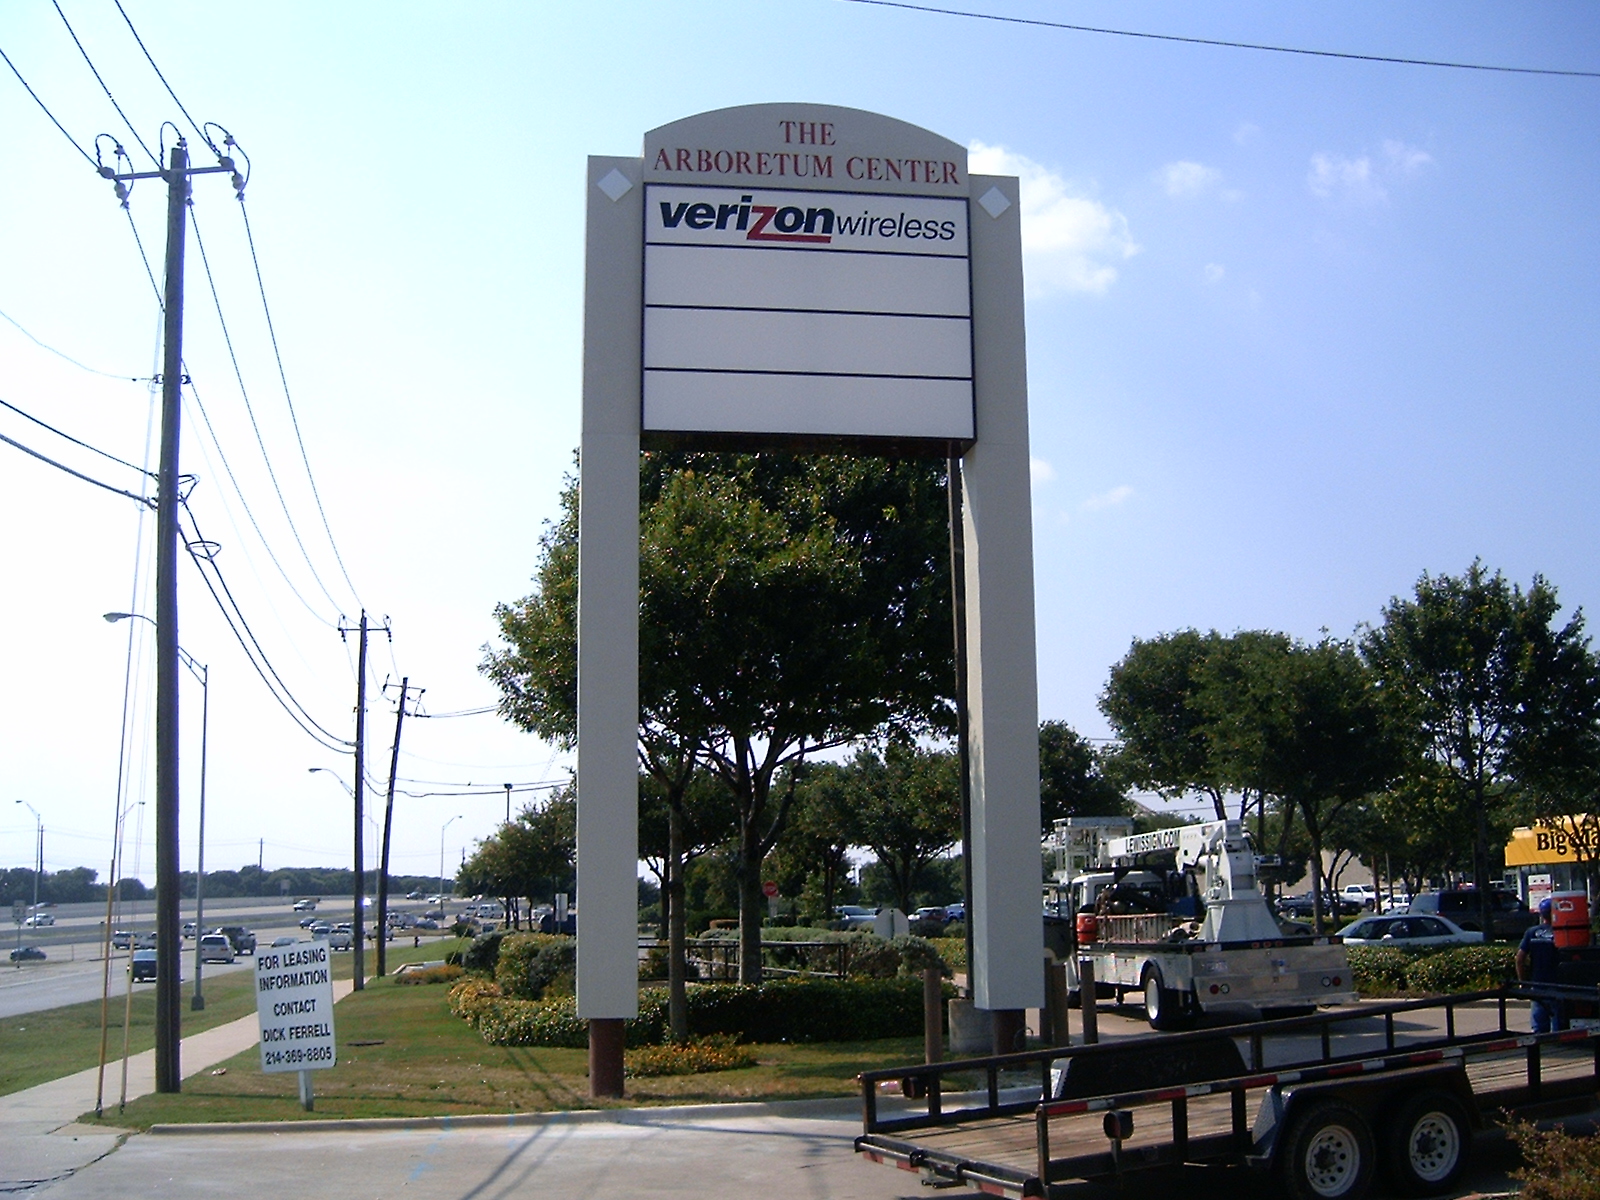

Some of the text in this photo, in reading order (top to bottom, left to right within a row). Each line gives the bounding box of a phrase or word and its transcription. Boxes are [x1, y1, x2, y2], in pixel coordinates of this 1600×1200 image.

[778, 120, 837, 146] THE
[653, 148, 960, 185] ARBORETUM CENTER
[659, 195, 956, 244] verizon wireless
[1536, 831, 1568, 856] Big
[258, 947, 326, 971] FOR LEASING
[259, 969, 328, 992] INFORMATION
[273, 998, 317, 1017] CONTACT
[263, 1023, 331, 1043] DICK FERRELL
